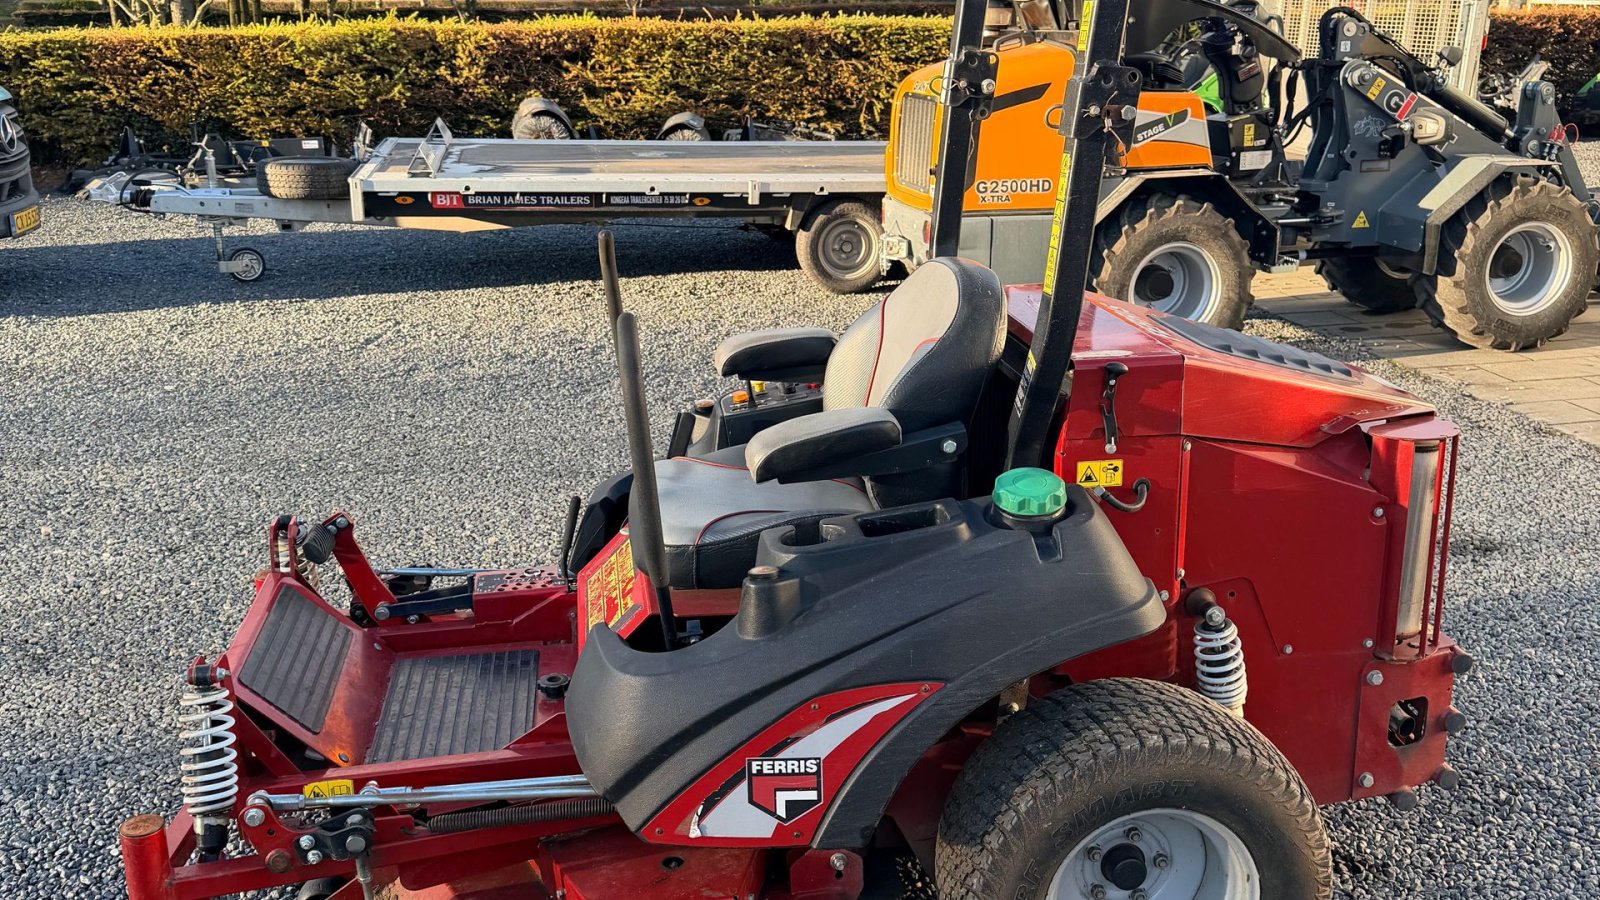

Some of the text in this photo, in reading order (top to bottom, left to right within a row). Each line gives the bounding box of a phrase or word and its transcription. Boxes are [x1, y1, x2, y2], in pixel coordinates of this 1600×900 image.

[1137, 113, 1175, 141] STAGE V
[976, 180, 1052, 193] G2500HD
[436, 194, 459, 205] BJT
[468, 196, 590, 205] BRIAN JAMES TRAILERS
[980, 195, 1011, 203] X-TRA
[751, 759, 818, 774] FERRIS
[1052, 779, 1195, 849] SMART
